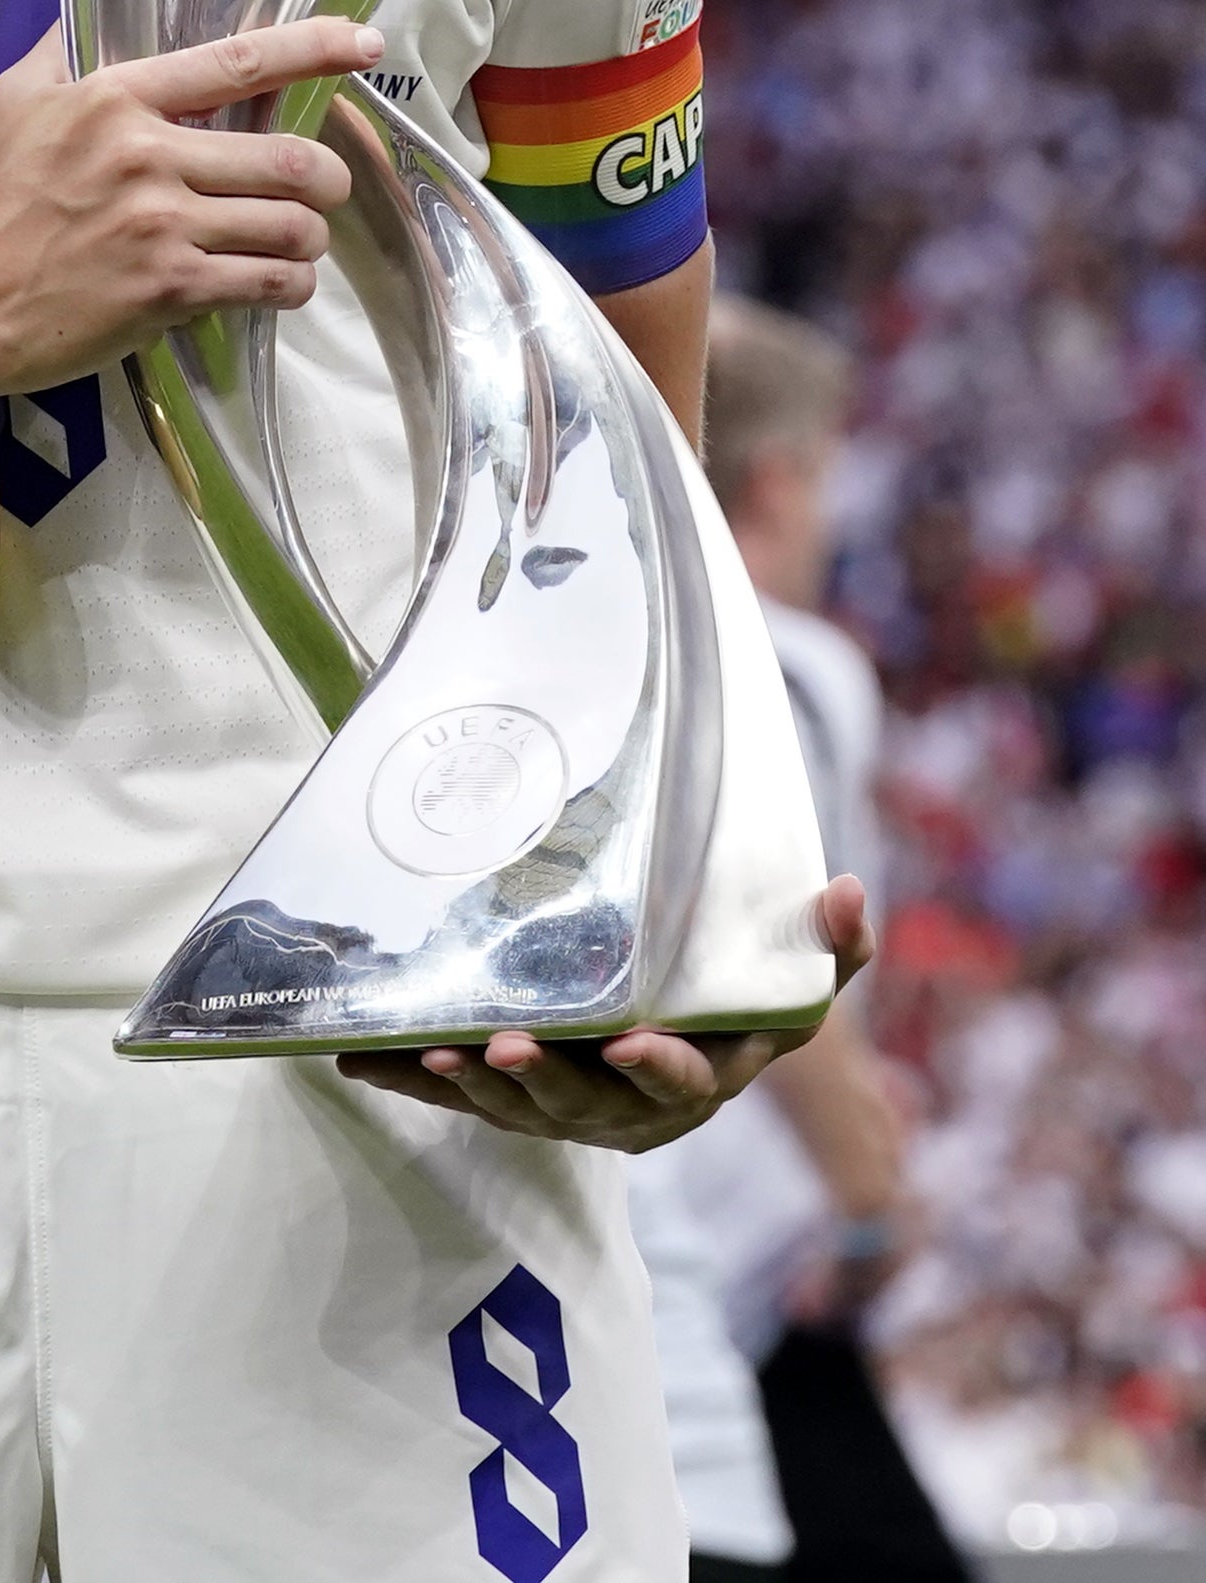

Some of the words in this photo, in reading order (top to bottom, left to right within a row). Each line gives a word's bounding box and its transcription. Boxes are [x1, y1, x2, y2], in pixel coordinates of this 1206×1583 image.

[592, 90, 703, 207] CAP
[422, 715, 535, 751] UEFA
[201, 994, 237, 1012] UEFA
[239, 986, 321, 1007] EUROPEAN
[448, 1262, 588, 1583] 8
